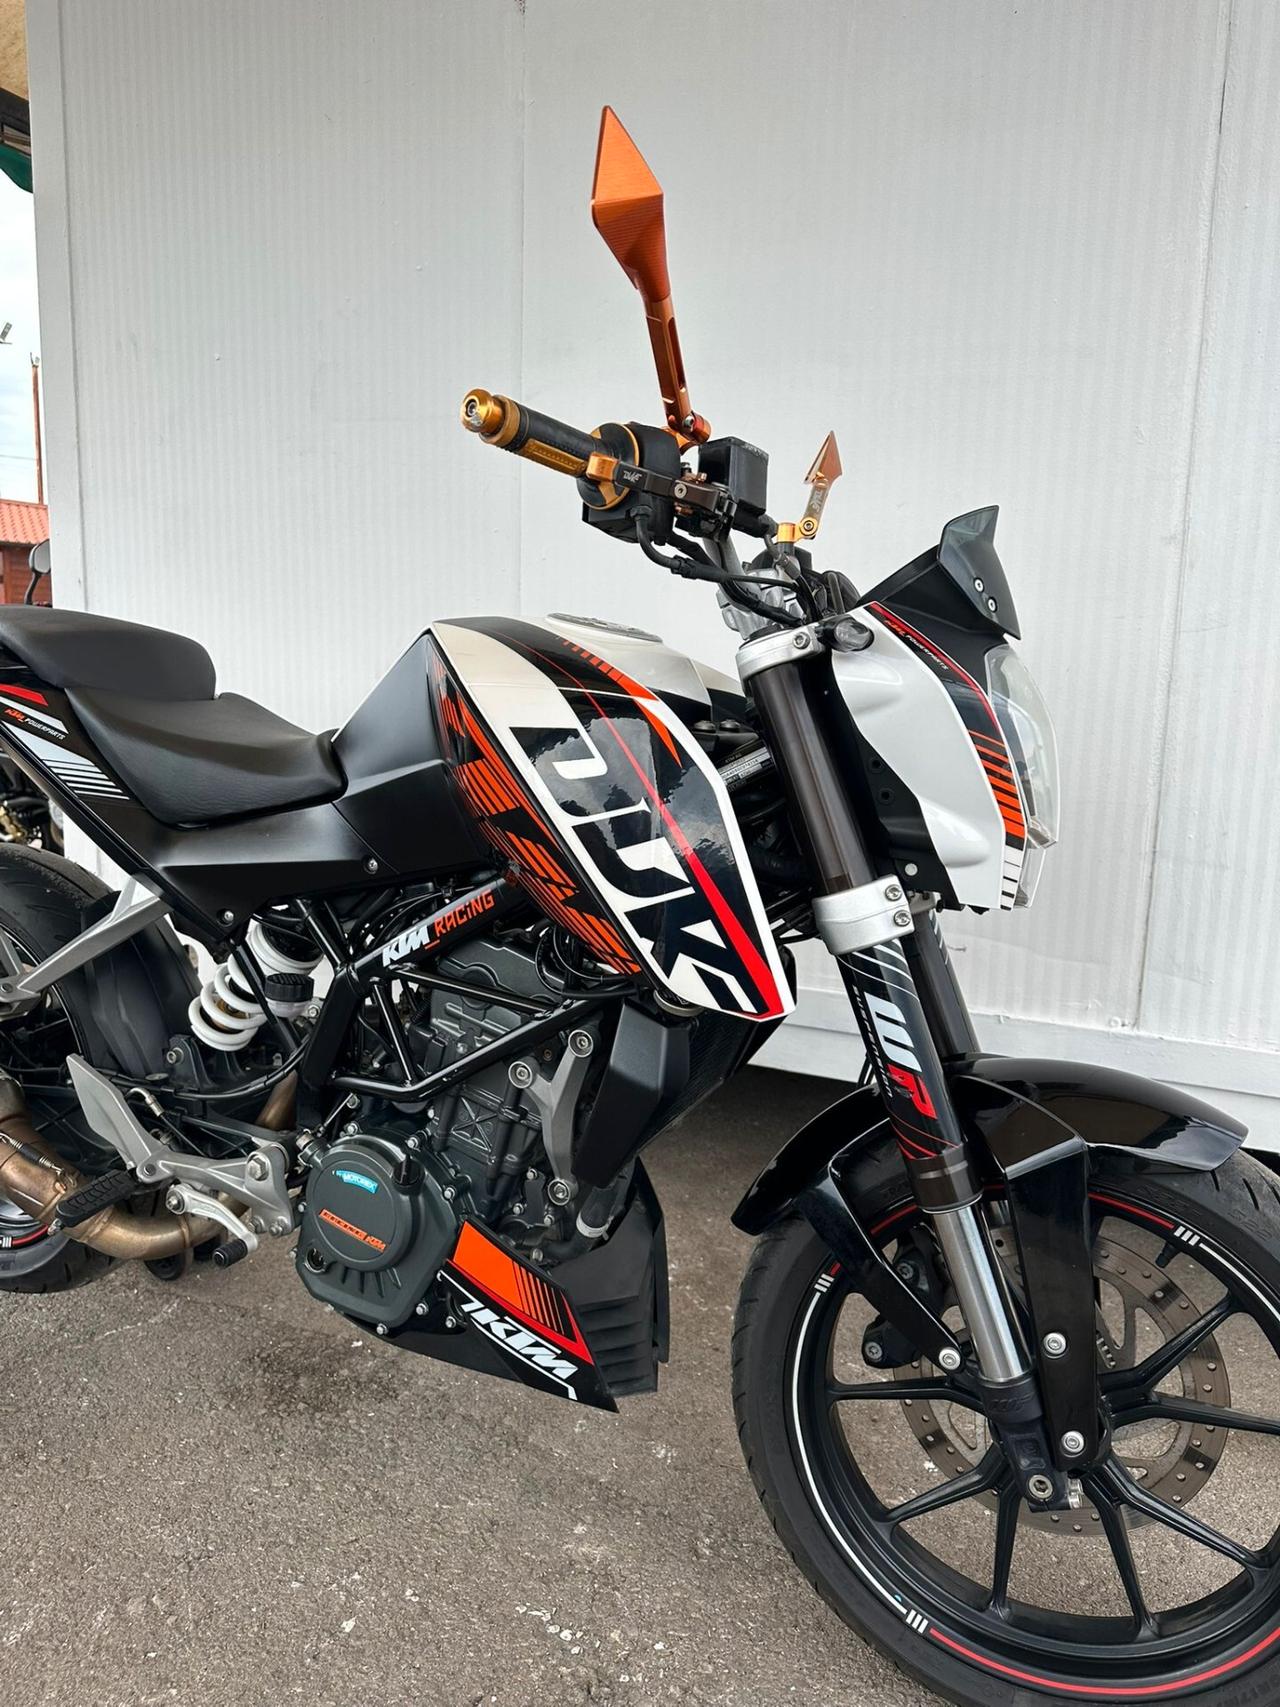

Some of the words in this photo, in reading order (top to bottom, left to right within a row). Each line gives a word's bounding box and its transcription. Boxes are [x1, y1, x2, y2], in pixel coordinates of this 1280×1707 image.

[24, 717, 66, 740] POWERPARTS
[382, 925, 431, 968] KTM
[863, 990, 938, 1120] WP
[470, 1307, 580, 1380] KTM
